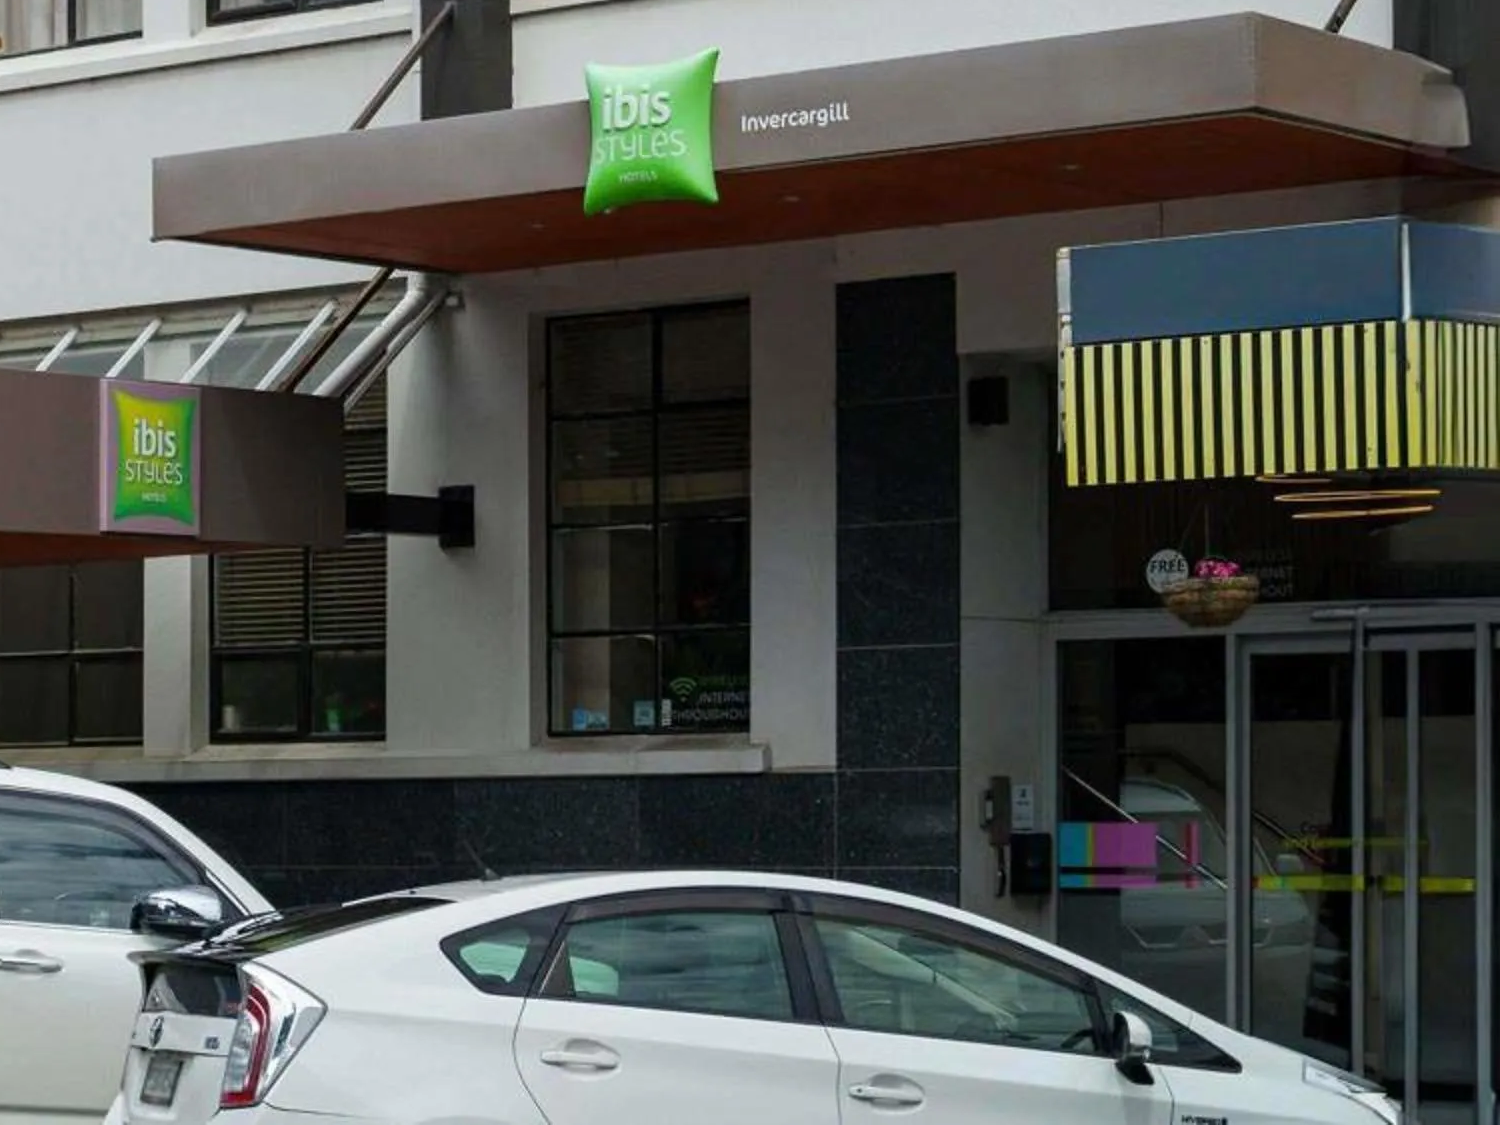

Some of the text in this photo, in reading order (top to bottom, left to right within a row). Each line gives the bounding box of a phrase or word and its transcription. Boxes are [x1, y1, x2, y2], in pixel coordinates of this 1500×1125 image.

[602, 84, 672, 133] ibis
[741, 102, 850, 133] Invercargill
[133, 417, 177, 458] ibis
[1150, 558, 1186, 574] FREE
